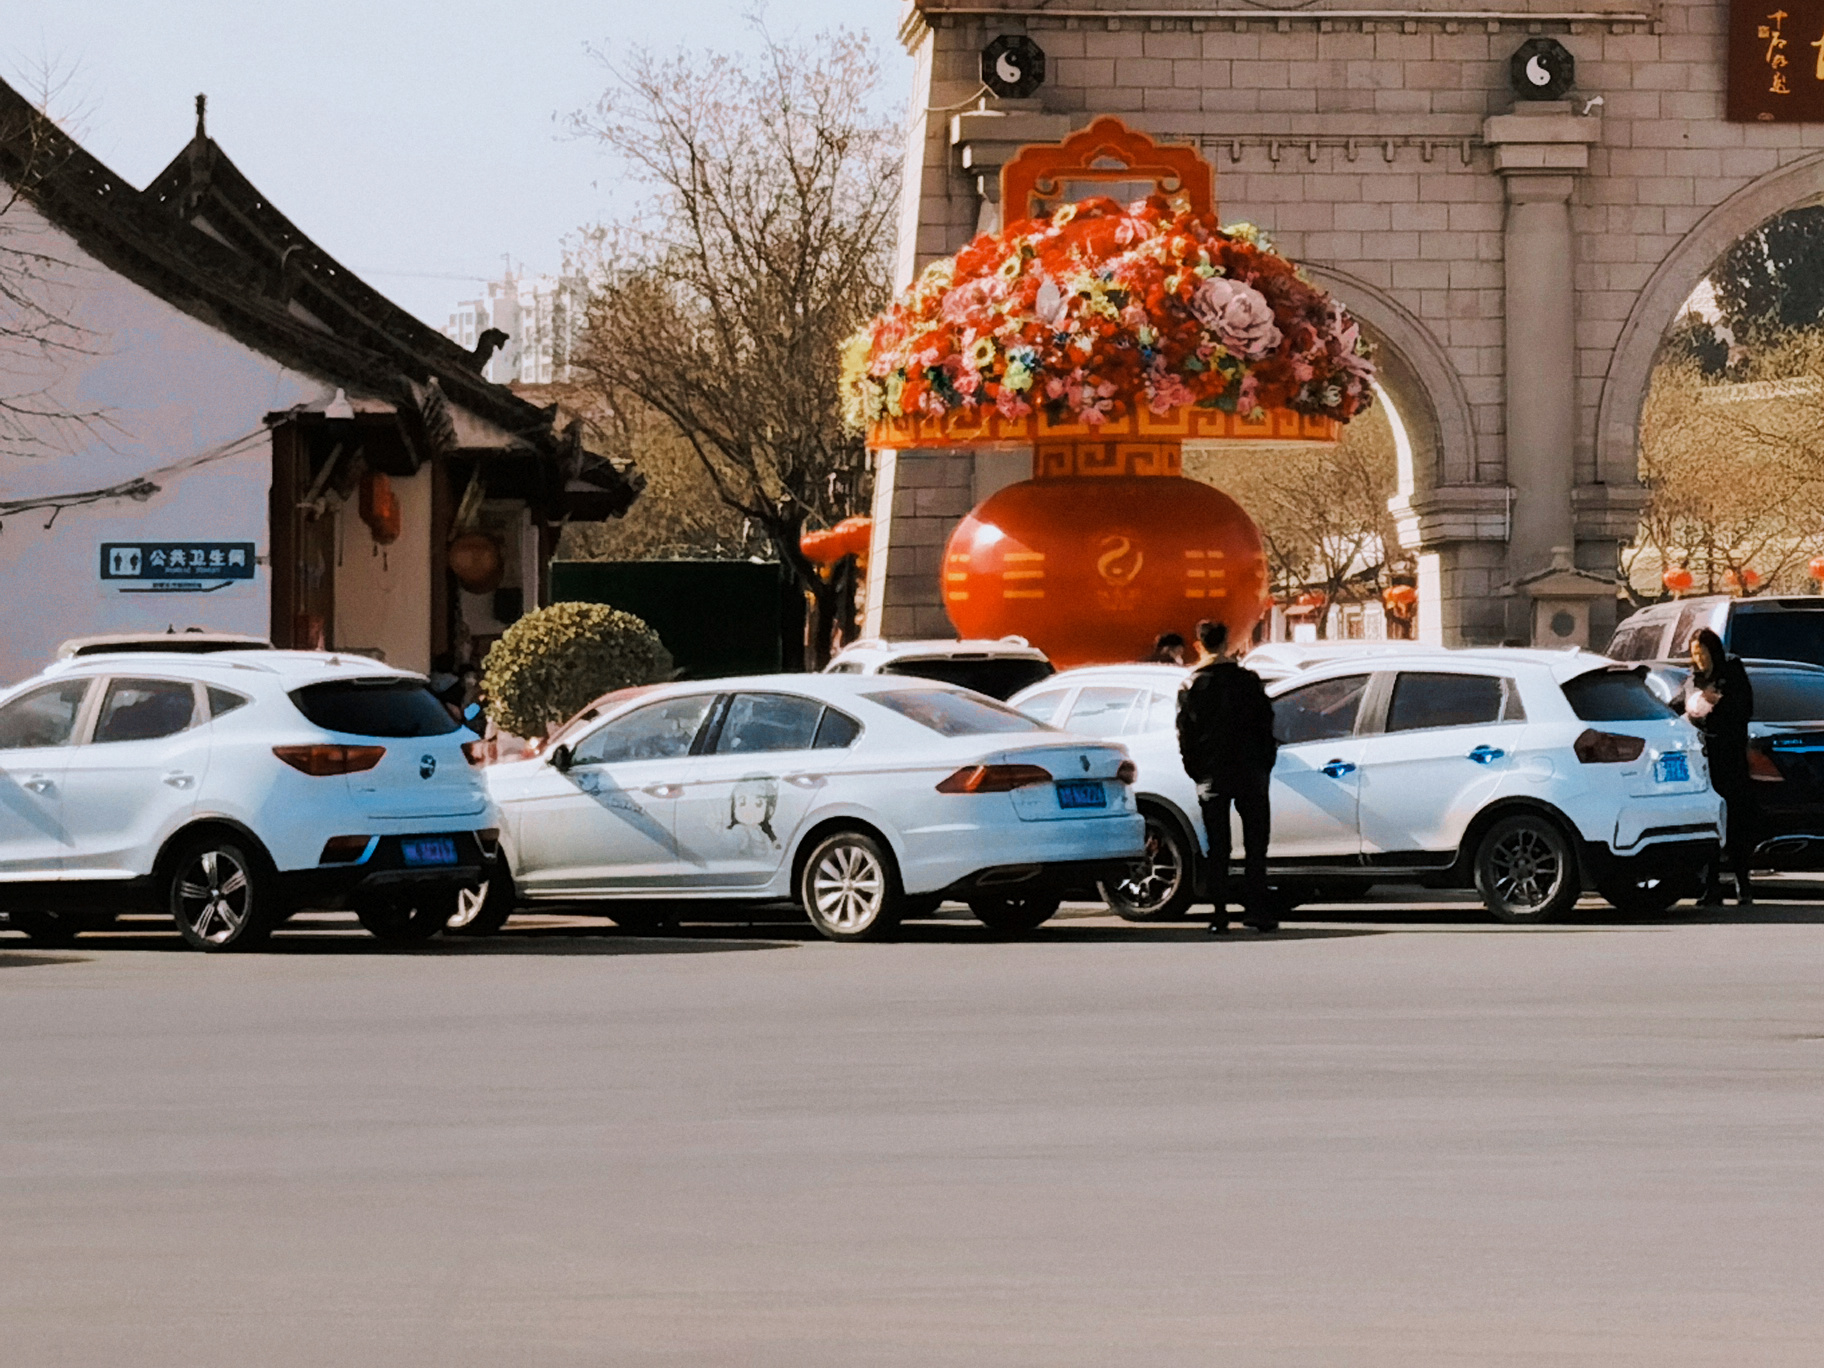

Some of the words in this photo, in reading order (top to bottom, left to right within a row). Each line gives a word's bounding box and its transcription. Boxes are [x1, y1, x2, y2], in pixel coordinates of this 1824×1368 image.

[149, 548, 245, 568] 公共卫生间
